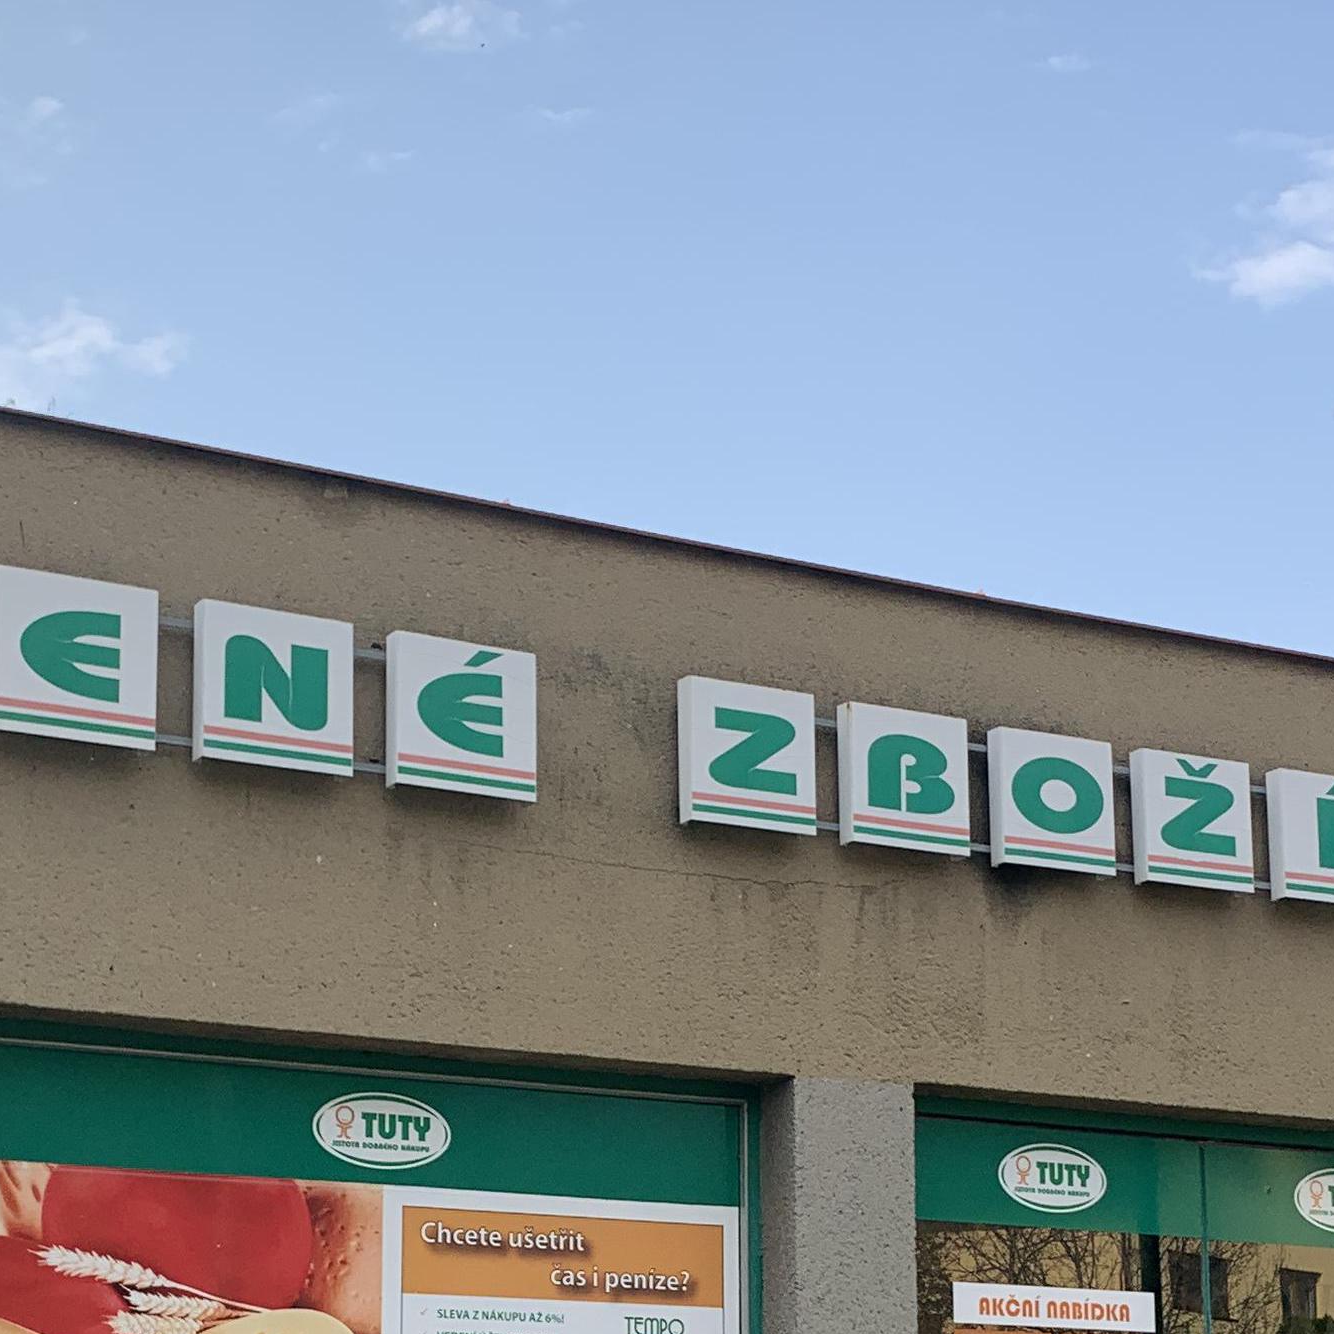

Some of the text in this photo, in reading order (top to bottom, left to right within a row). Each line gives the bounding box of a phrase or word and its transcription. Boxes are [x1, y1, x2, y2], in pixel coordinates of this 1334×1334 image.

[361, 1112, 431, 1142] TUTY
[1036, 1161, 1090, 1187] TUTY
[420, 1221, 585, 1251] Chcete ušetřit
[550, 1263, 691, 1292] čas i peníze?
[437, 1308, 469, 1320] SLEVA
[472, 1310, 479, 1320] Z
[481, 1308, 526, 1322] NÁKUPU
[529, 1309, 542, 1322] AŽ
[978, 1294, 1131, 1323] AKČNÍ NABÍDKA
